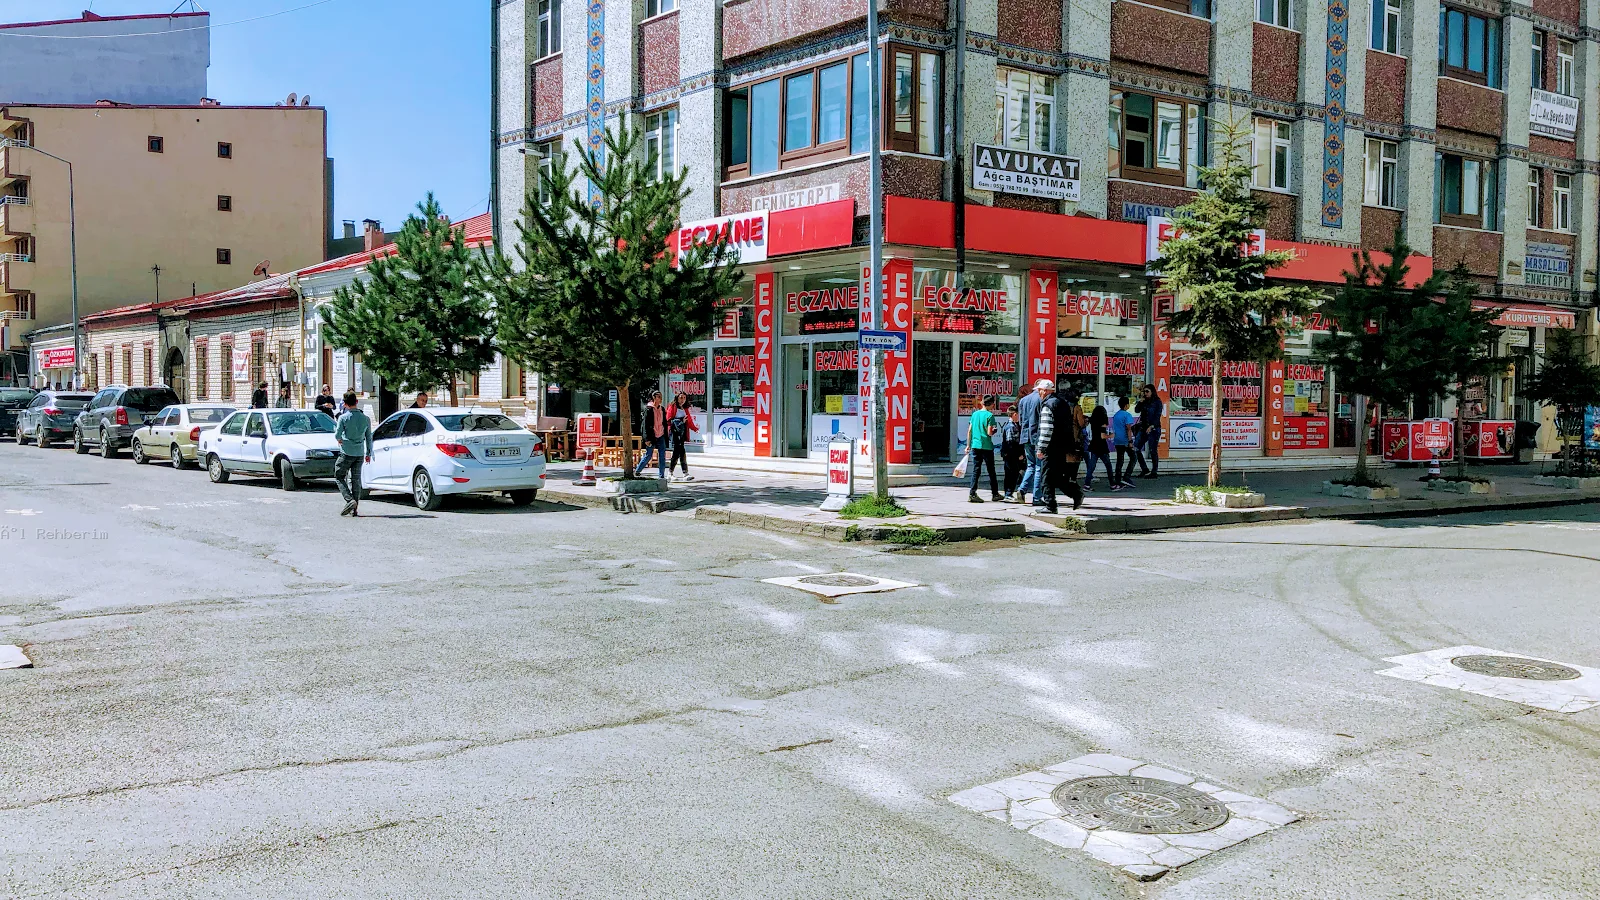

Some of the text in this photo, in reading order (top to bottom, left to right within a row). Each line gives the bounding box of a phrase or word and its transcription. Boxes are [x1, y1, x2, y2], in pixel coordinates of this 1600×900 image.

[978, 149, 1079, 179] AVUKAT
[983, 170, 1074, 190] Ağca BAŞTİMAR
[754, 191, 804, 212] CENNET
[680, 216, 764, 251] ECZANE
[1525, 256, 1568, 272] MASALLAH
[1553, 275, 1569, 288] APT
[786, 286, 859, 314] ECZANE
[923, 285, 1008, 312] ECZANE
[1065, 294, 1139, 320] ECZANE
[1505, 313, 1551, 326] KURUYEMİŞ
[714, 354, 755, 374] ECZANE
[757, 282, 771, 443] ECZANE
[815, 350, 859, 372] ECZANE
[962, 351, 1016, 373] ECZANE
[1056, 354, 1099, 375] ECZANE
[1105, 356, 1146, 376] ECZANE
[1171, 359, 1213, 377] ECZANE
[1221, 360, 1261, 378] ECZANE
[1287, 363, 1325, 381] ECZANE
[965, 375, 1014, 397] YETİMOĞLU
[1171, 380, 1213, 399] YETİMOĞLU
[1222, 381, 1261, 399] YETİMOĞLU
[722, 426, 742, 441] SGK
[1179, 430, 1198, 443] SGK
